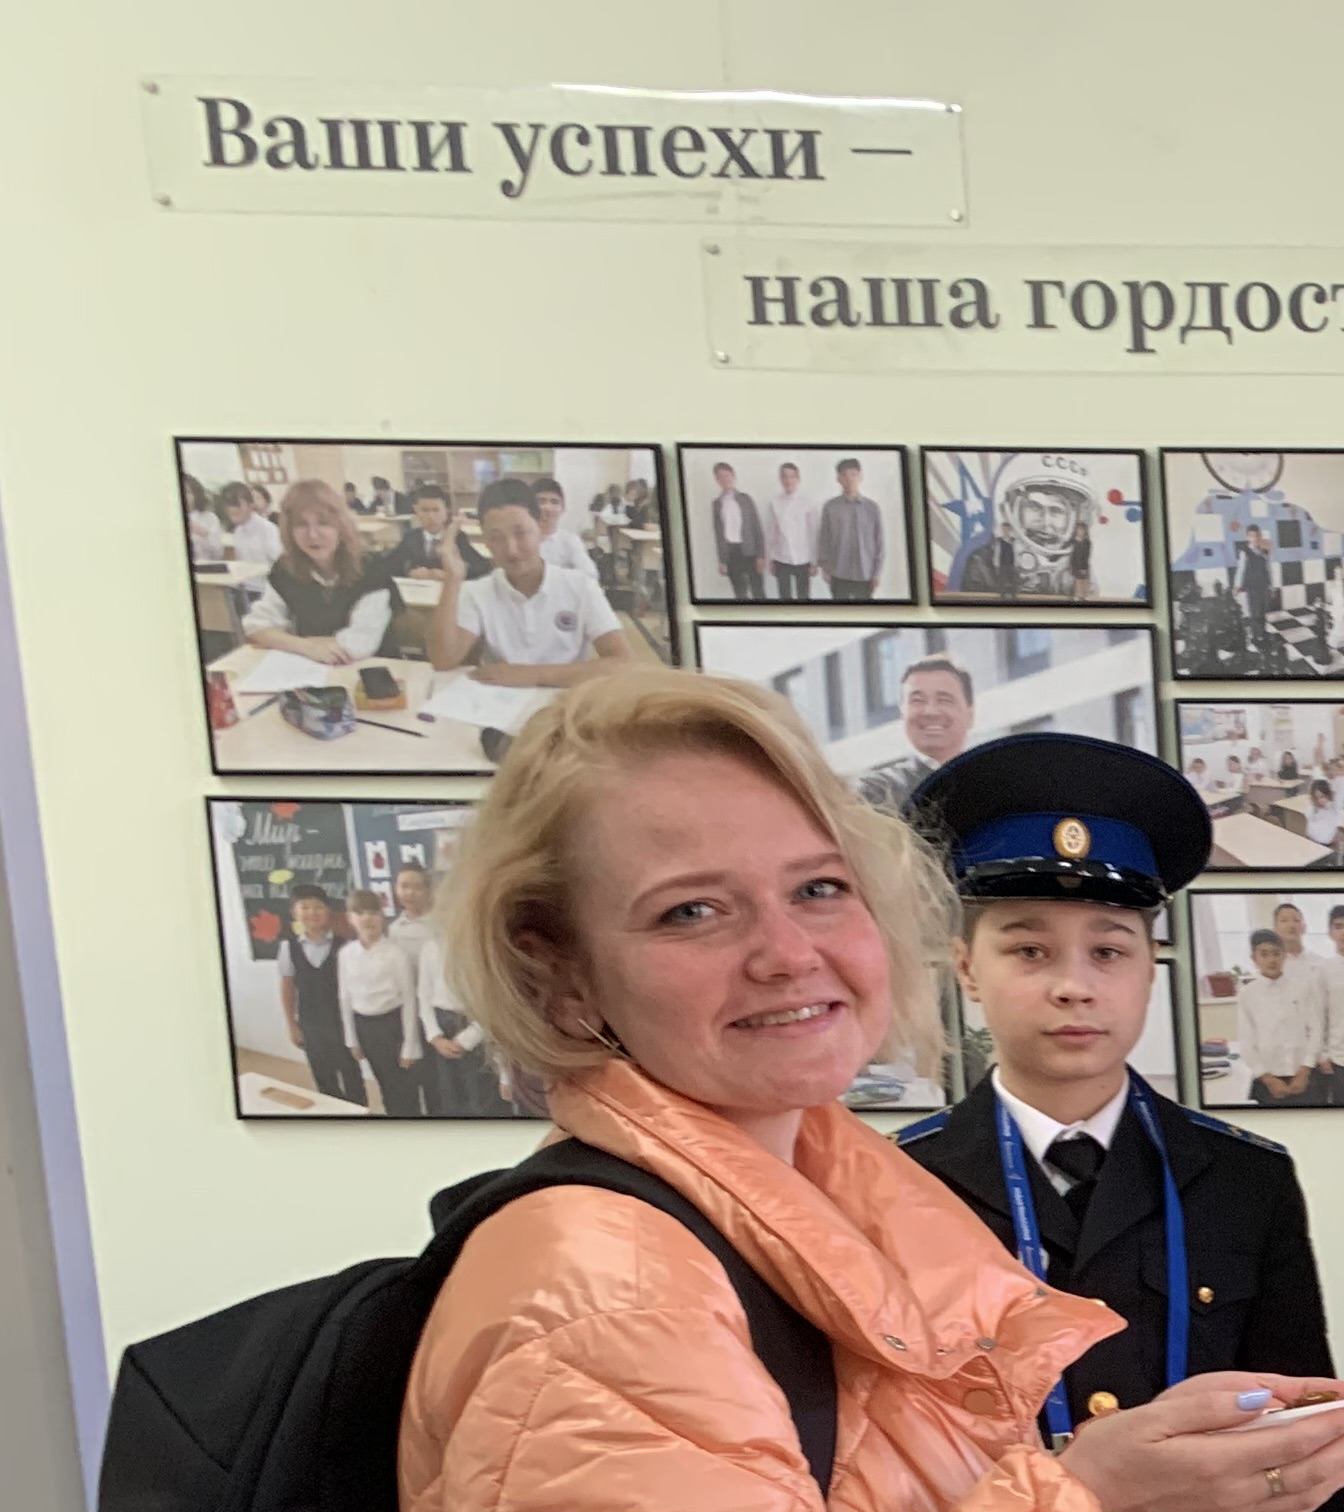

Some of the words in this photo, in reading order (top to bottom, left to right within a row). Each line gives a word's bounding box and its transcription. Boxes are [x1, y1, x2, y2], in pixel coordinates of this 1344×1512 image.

[197, 97, 472, 173] Ваши
[493, 122, 825, 199] успехи
[743, 275, 999, 330] наша
